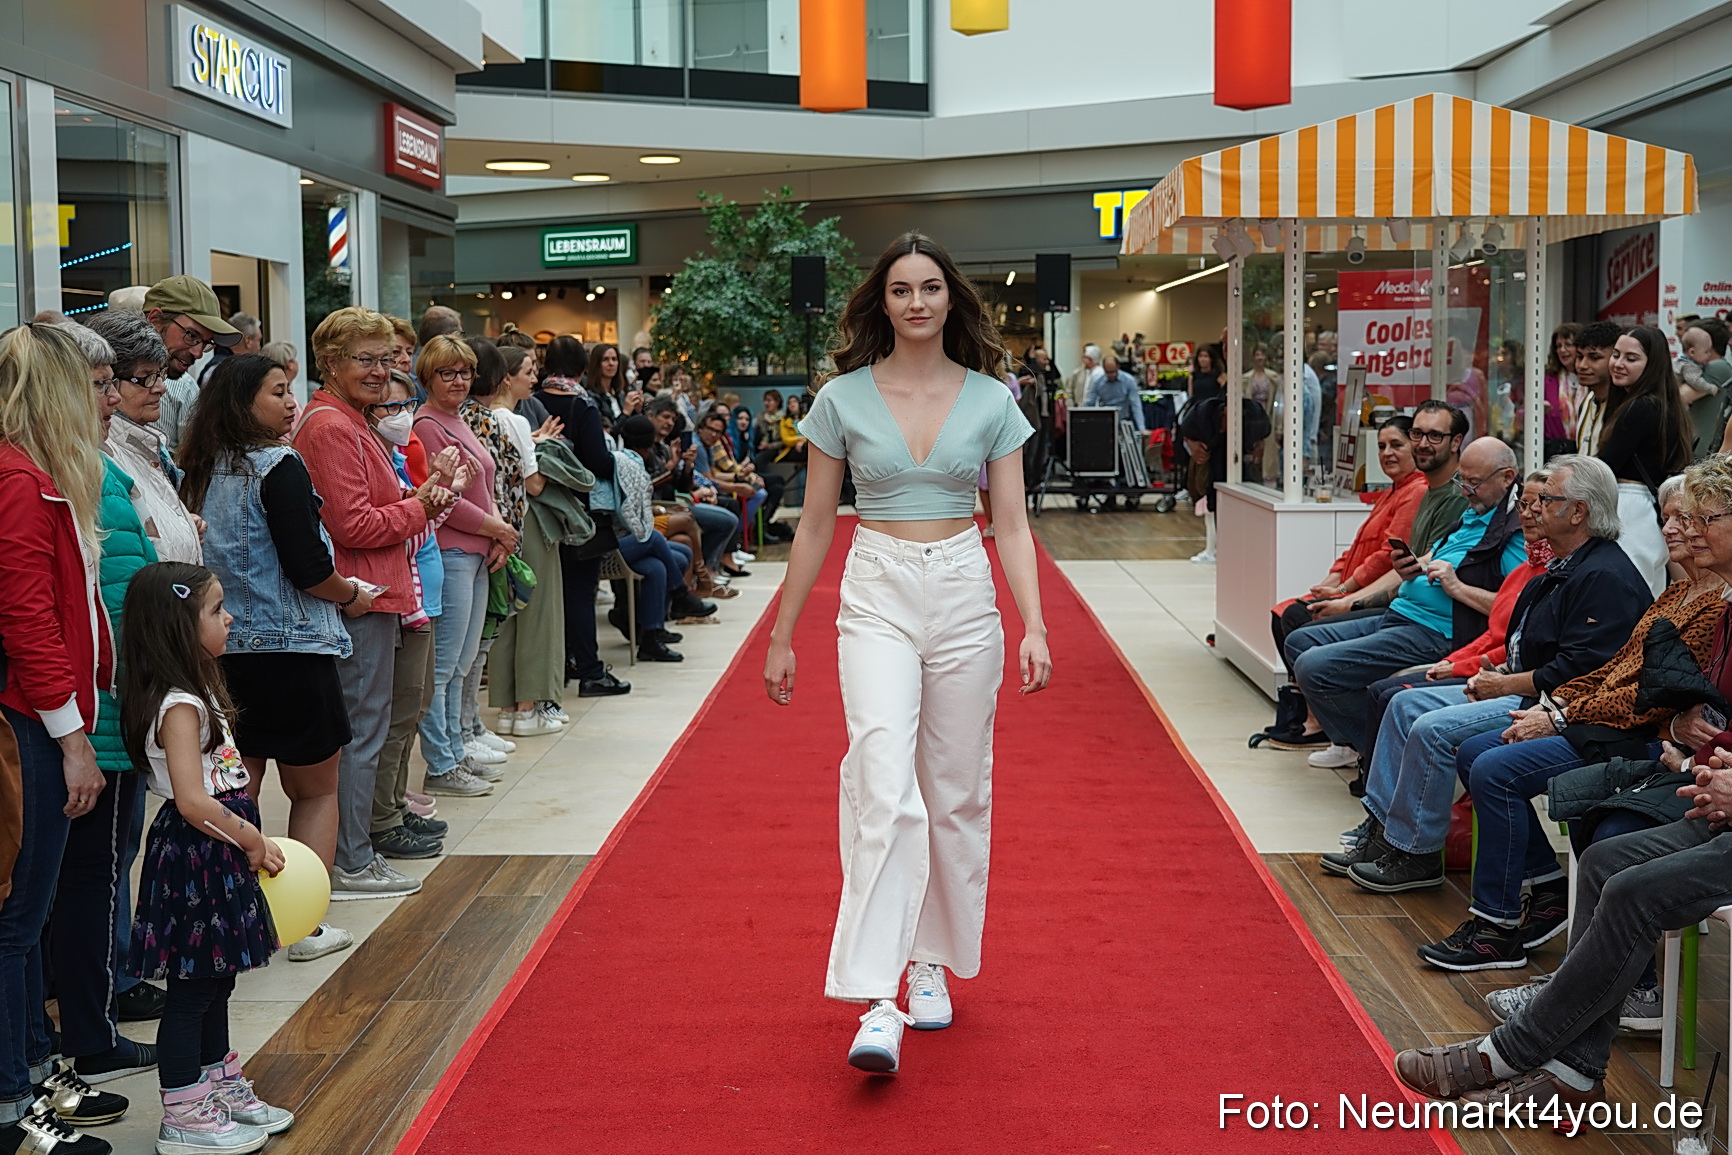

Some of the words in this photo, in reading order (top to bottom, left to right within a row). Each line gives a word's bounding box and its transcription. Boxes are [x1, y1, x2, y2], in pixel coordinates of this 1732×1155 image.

[191, 24, 287, 115] STARCUT
[399, 130, 438, 166] LEBENSRAUM
[549, 236, 626, 254] LEBENSRAUM
[1606, 232, 1655, 299] Service
[1703, 281, 1732, 292] Onlin
